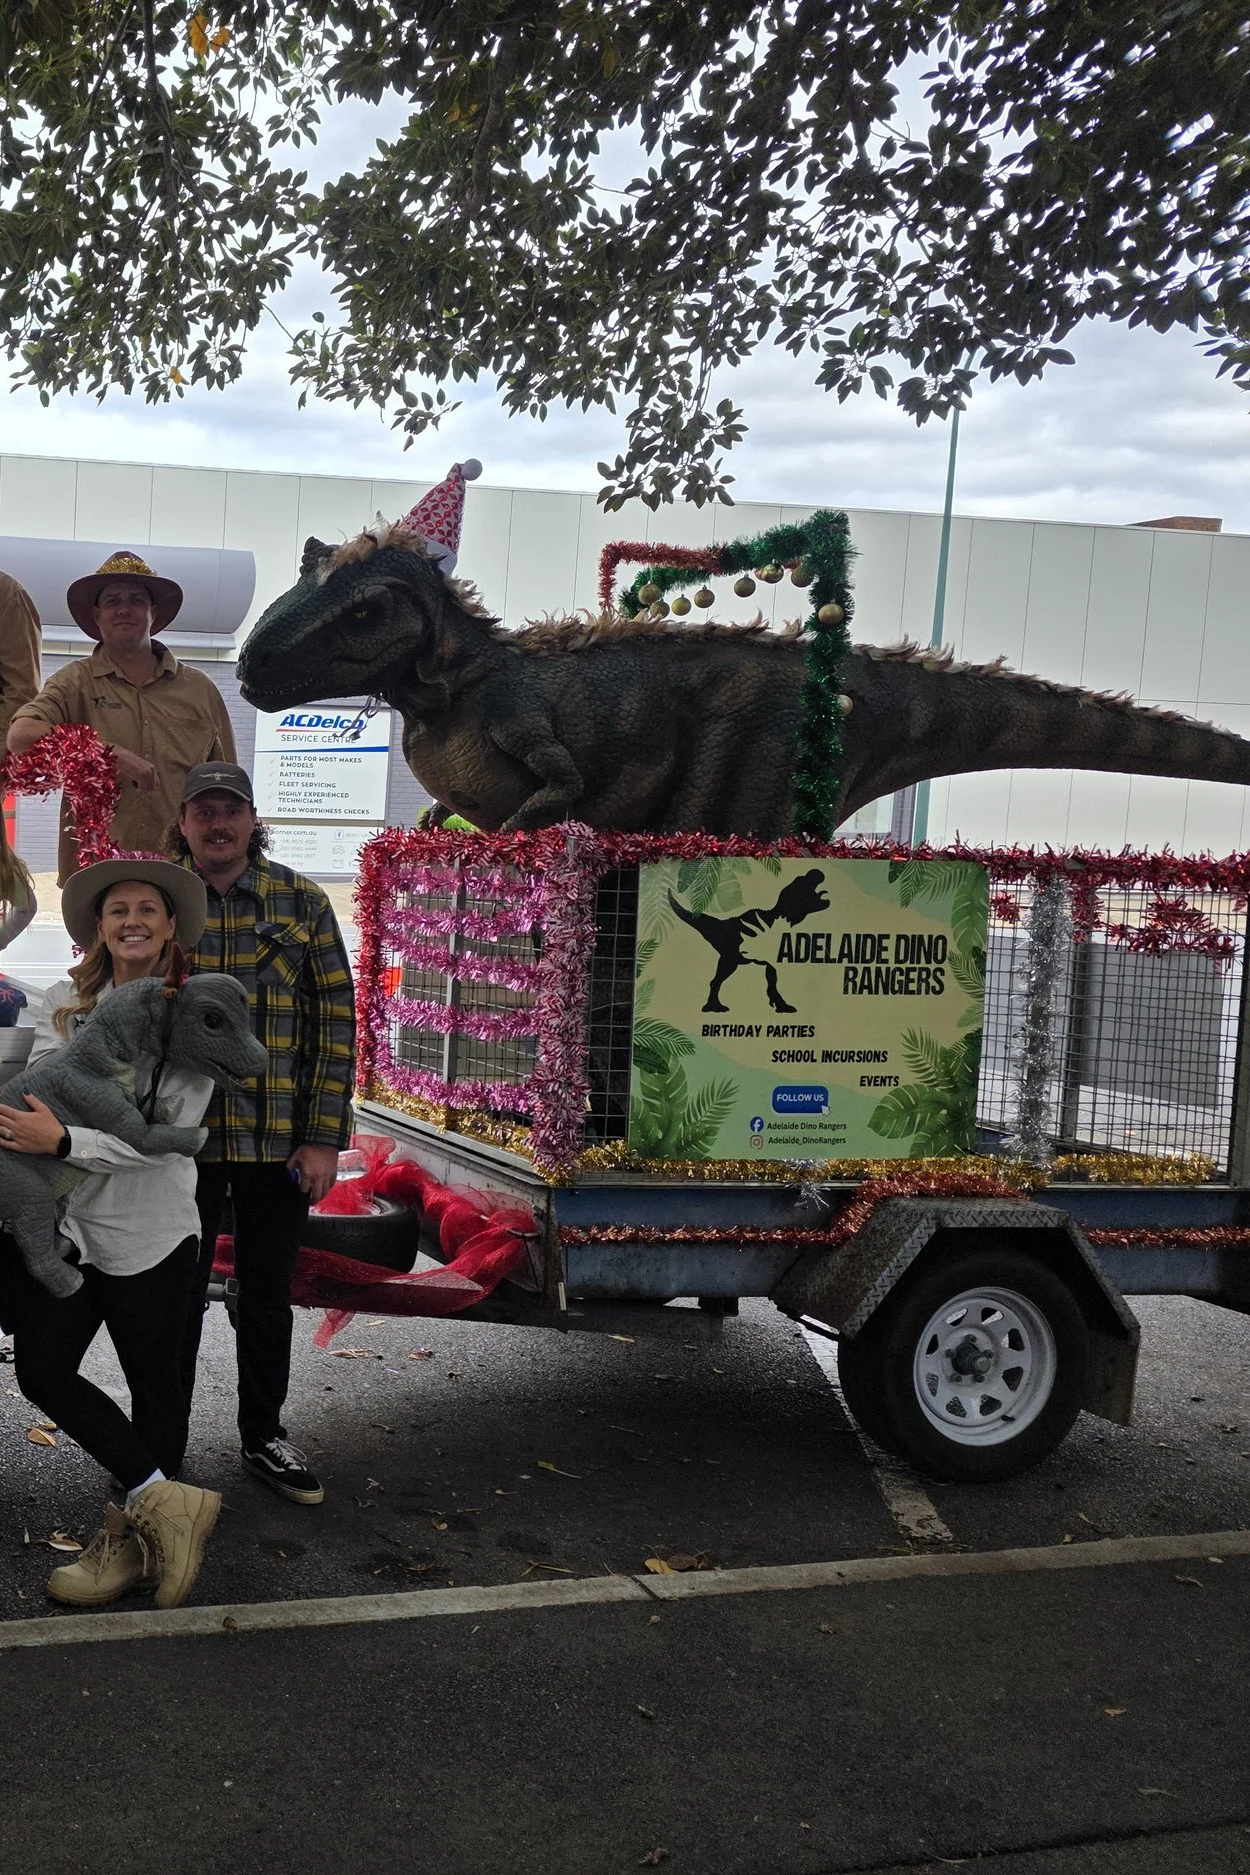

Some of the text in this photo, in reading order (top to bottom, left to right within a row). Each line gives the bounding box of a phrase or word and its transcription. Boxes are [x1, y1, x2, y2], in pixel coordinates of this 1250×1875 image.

[280, 714, 365, 729] ACDelco
[281, 734, 319, 743] SERVICE
[776, 932, 948, 965] ADELAIDE DINO
[842, 966, 946, 996] RANGERS
[701, 1024, 815, 1038] BIRTHDAY PARTIES
[771, 1049, 888, 1063] SCHOOL INCURSIONS
[859, 1075, 900, 1087] EVENTS
[776, 1093, 824, 1102] FOLLOW US
[767, 1122, 847, 1132] Adelaide Dino Rangers
[768, 1136, 847, 1145] Adelaide_DinoRangers
